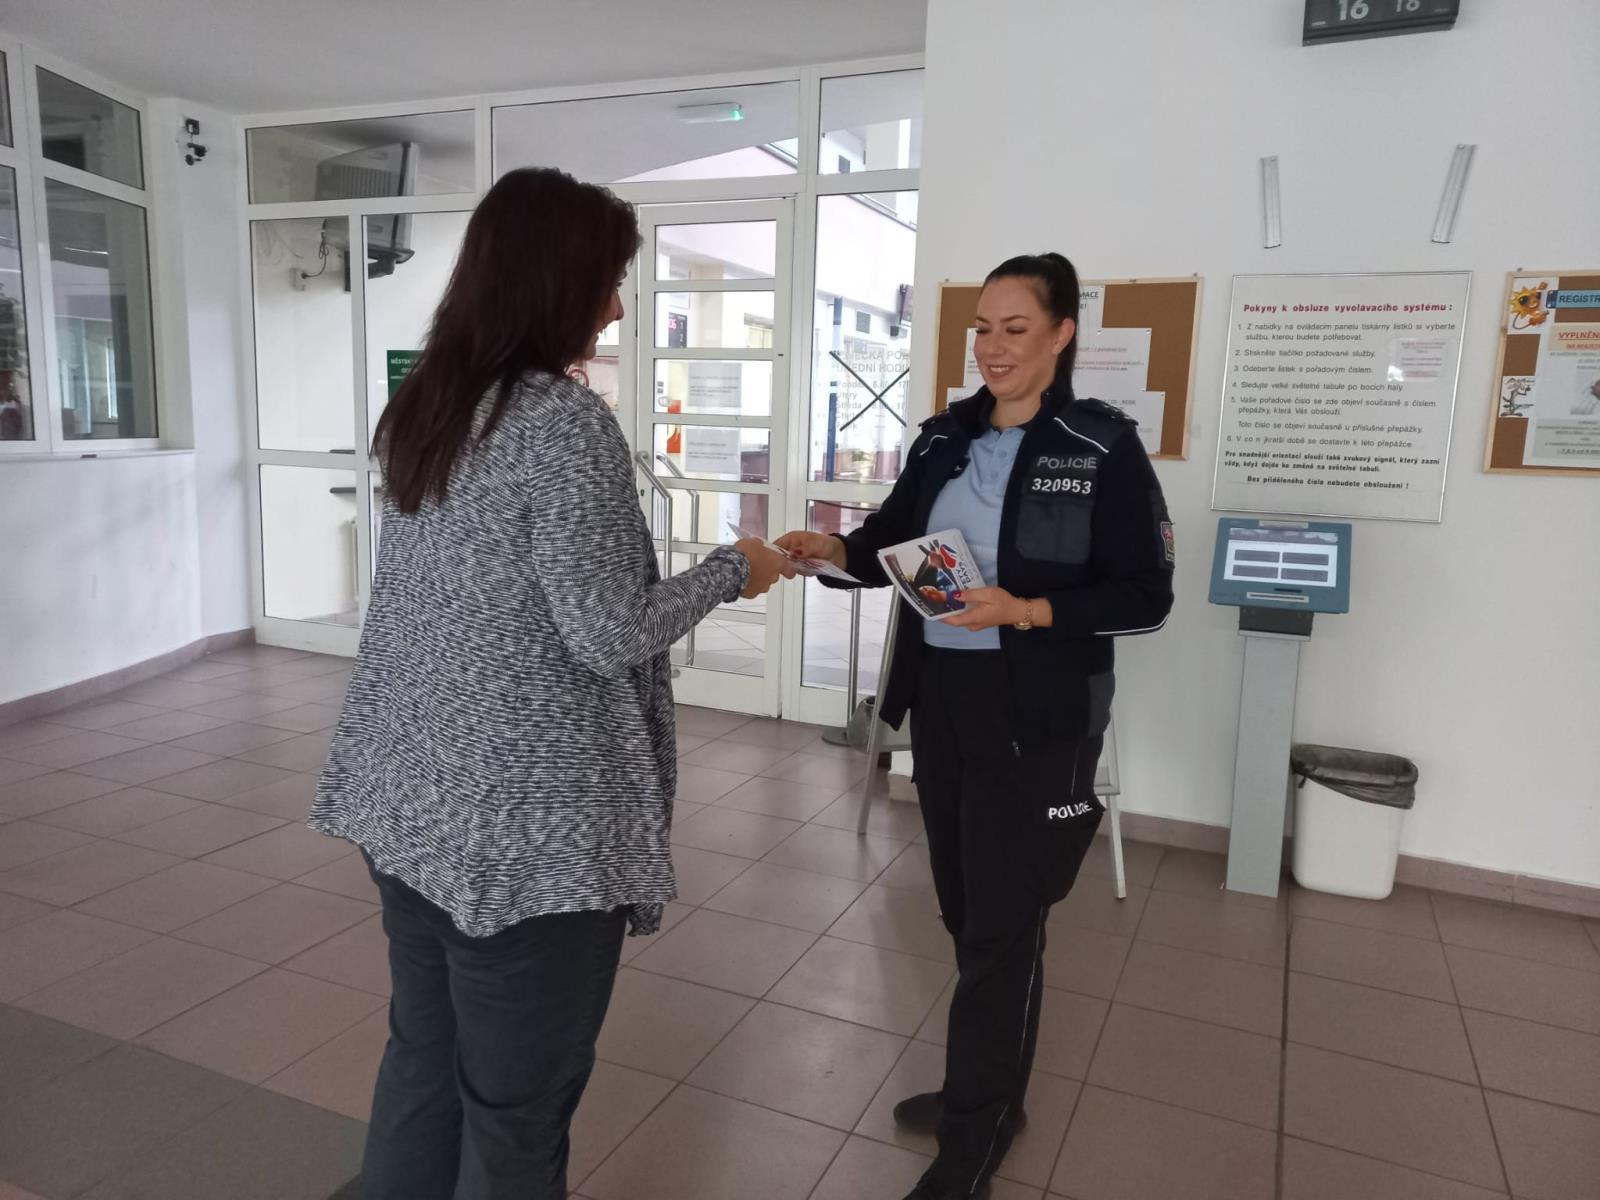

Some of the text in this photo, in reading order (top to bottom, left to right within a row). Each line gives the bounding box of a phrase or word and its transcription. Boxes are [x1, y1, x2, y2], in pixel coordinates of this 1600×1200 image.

[1244, 304, 1276, 313] Pokyny
[1282, 304, 1287, 312] k
[1426, 323, 1455, 331] vyberte
[1306, 366, 1345, 374] pořadovým
[1037, 456, 1097, 469] POLICIE
[1032, 478, 1092, 494] 320953
